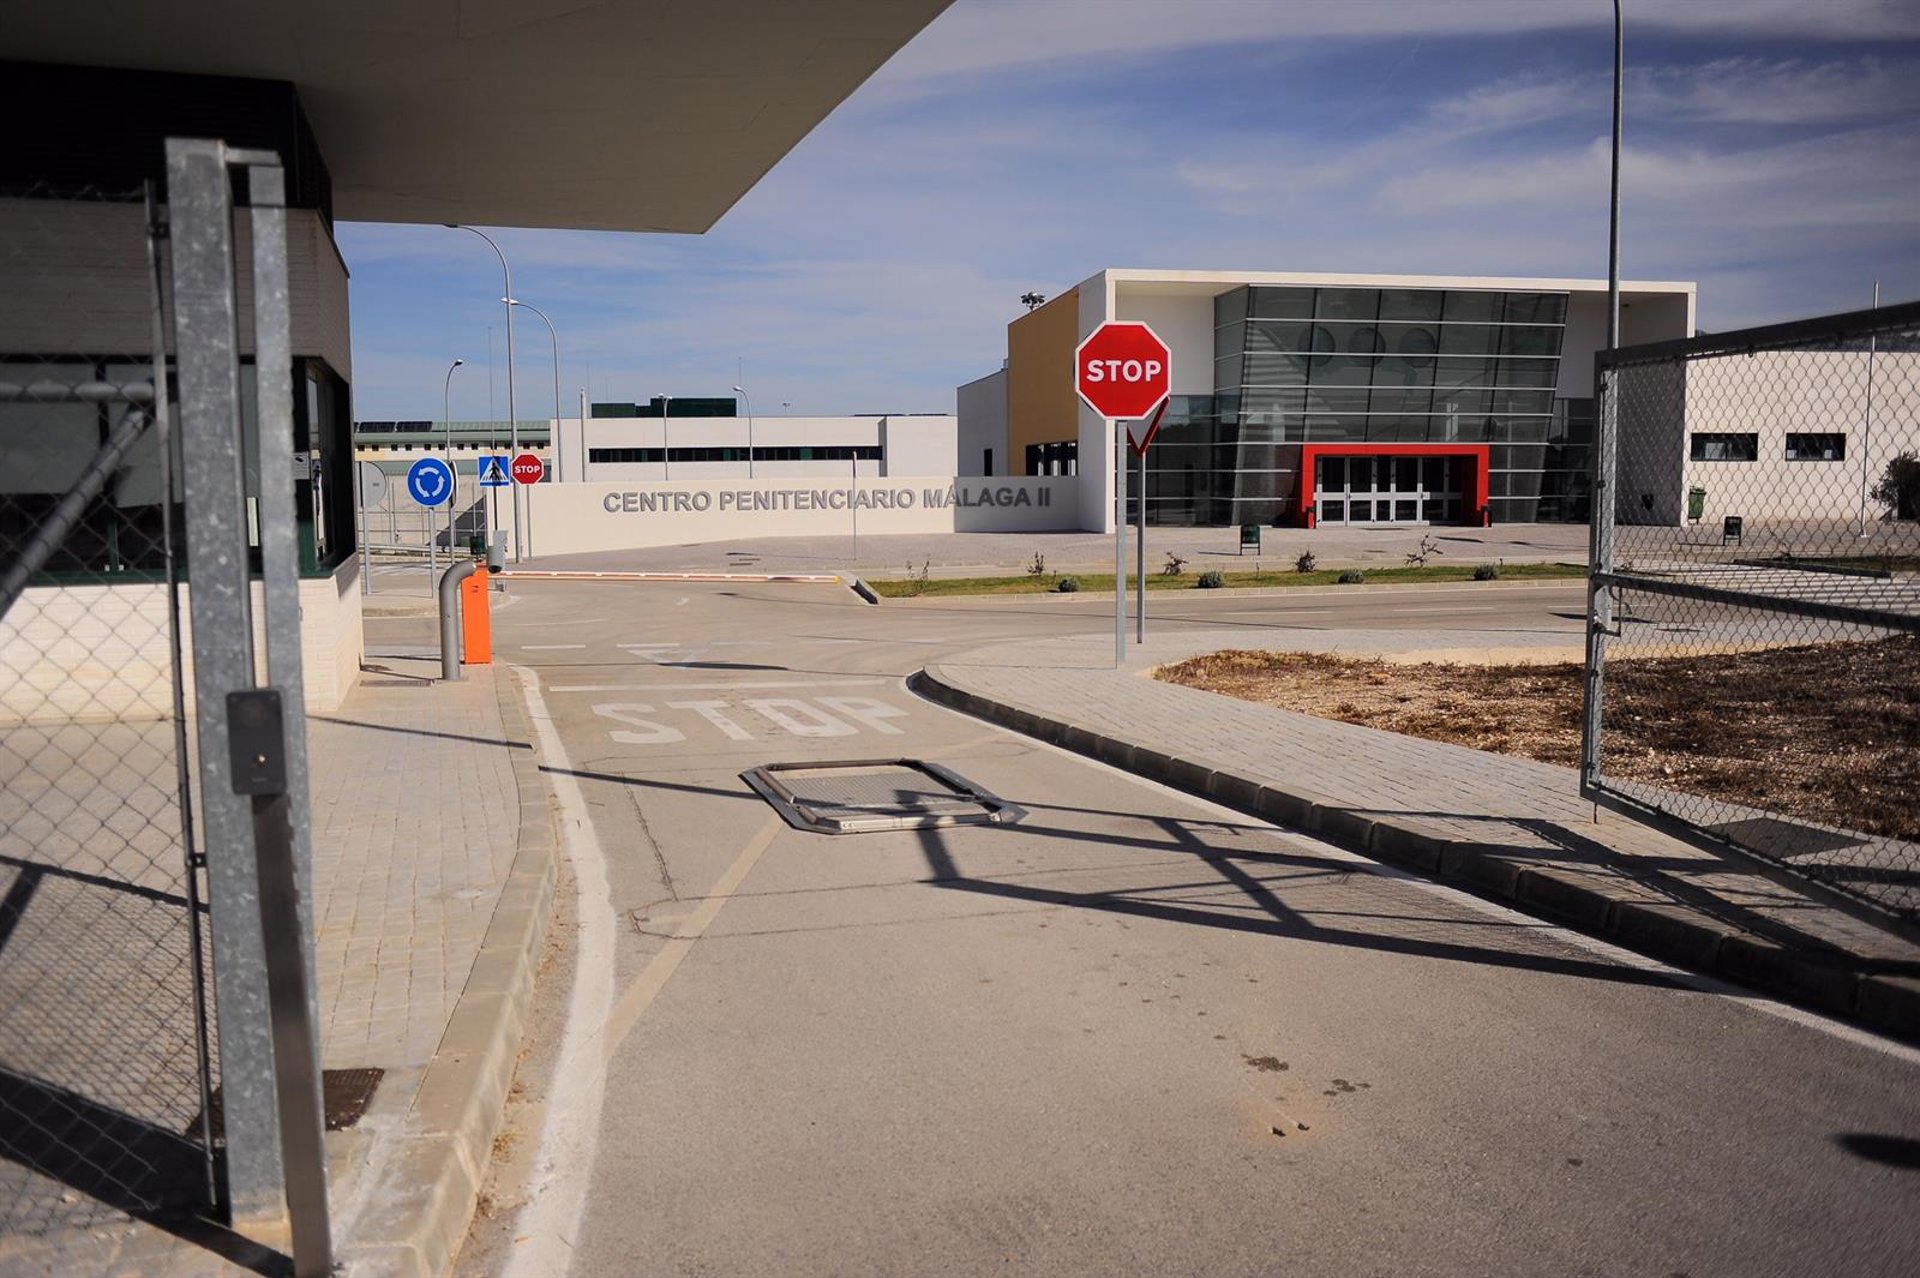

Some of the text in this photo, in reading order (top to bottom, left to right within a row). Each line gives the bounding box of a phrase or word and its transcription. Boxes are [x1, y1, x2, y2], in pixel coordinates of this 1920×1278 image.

[1086, 359, 1162, 382] STOP
[514, 465, 541, 474] STOP
[603, 484, 1050, 513] CENTRO PENITENCIARIO MÁLAGA II
[591, 696, 910, 744] STOP
